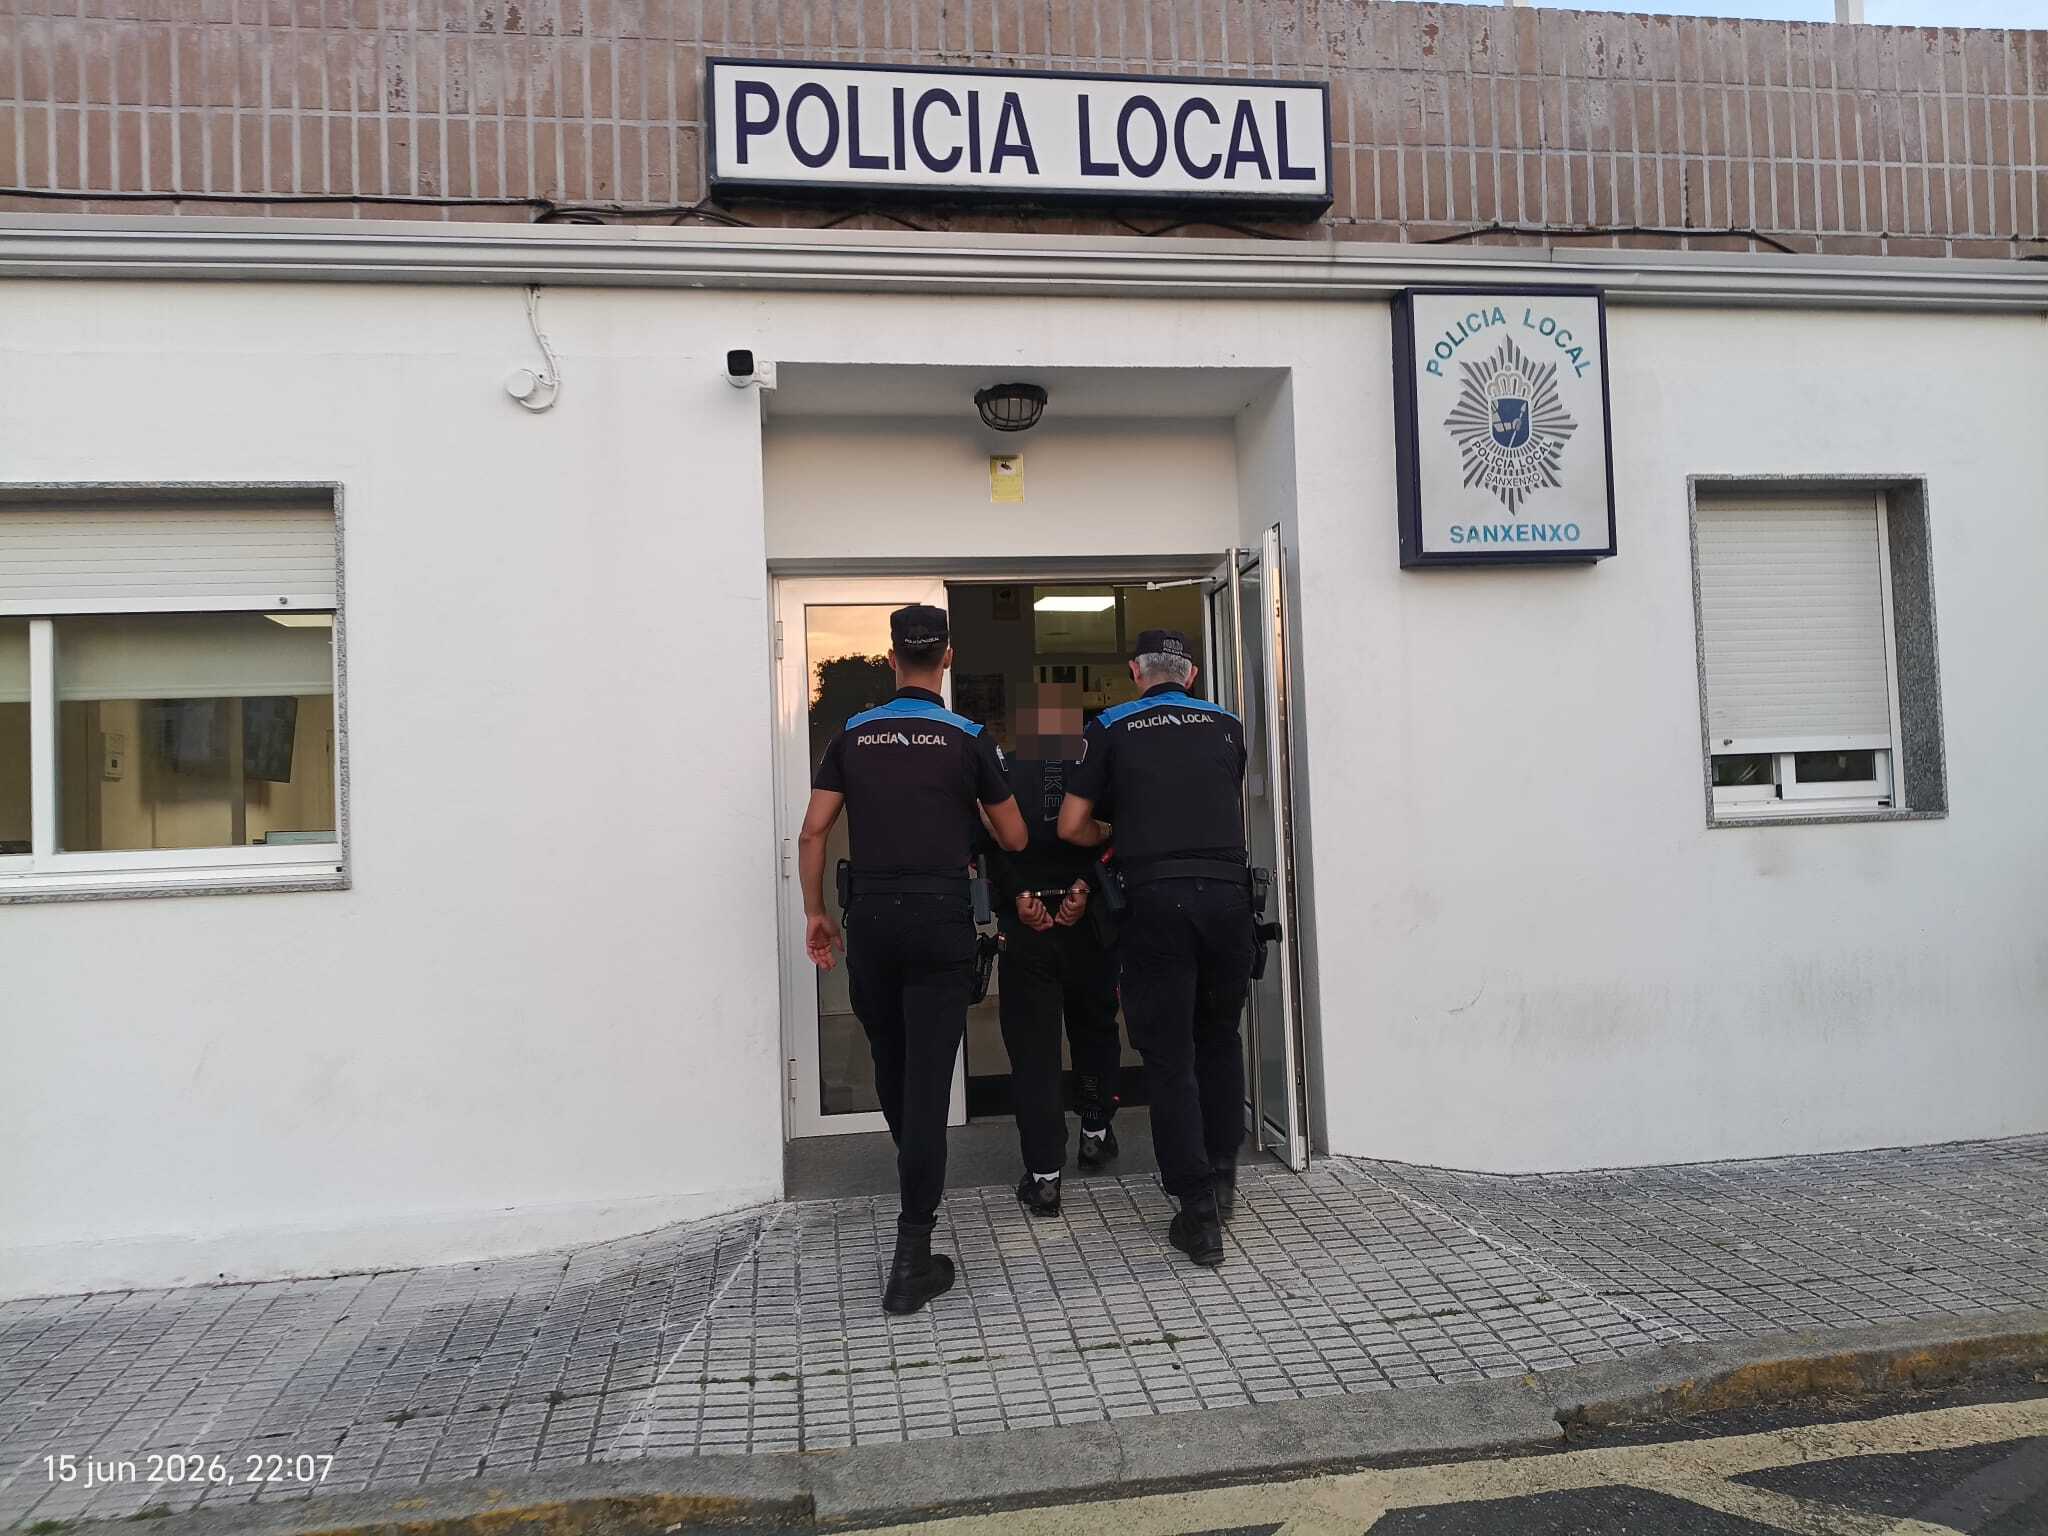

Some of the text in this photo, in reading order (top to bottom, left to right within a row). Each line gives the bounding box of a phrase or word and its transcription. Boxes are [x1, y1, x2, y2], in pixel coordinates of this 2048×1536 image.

[735, 80, 1317, 181] POLICIA LOCAL
[1426, 306, 1592, 378] POLICIA LOCAL
[1472, 440, 1553, 469] POLICIA LOCAL
[1485, 473, 1541, 487] SANXENXO
[1450, 524, 1580, 544] SANXENXO
[1128, 713, 1215, 731] POLICÍA LOCAL
[857, 732, 948, 746] POLICÍA LOCAL
